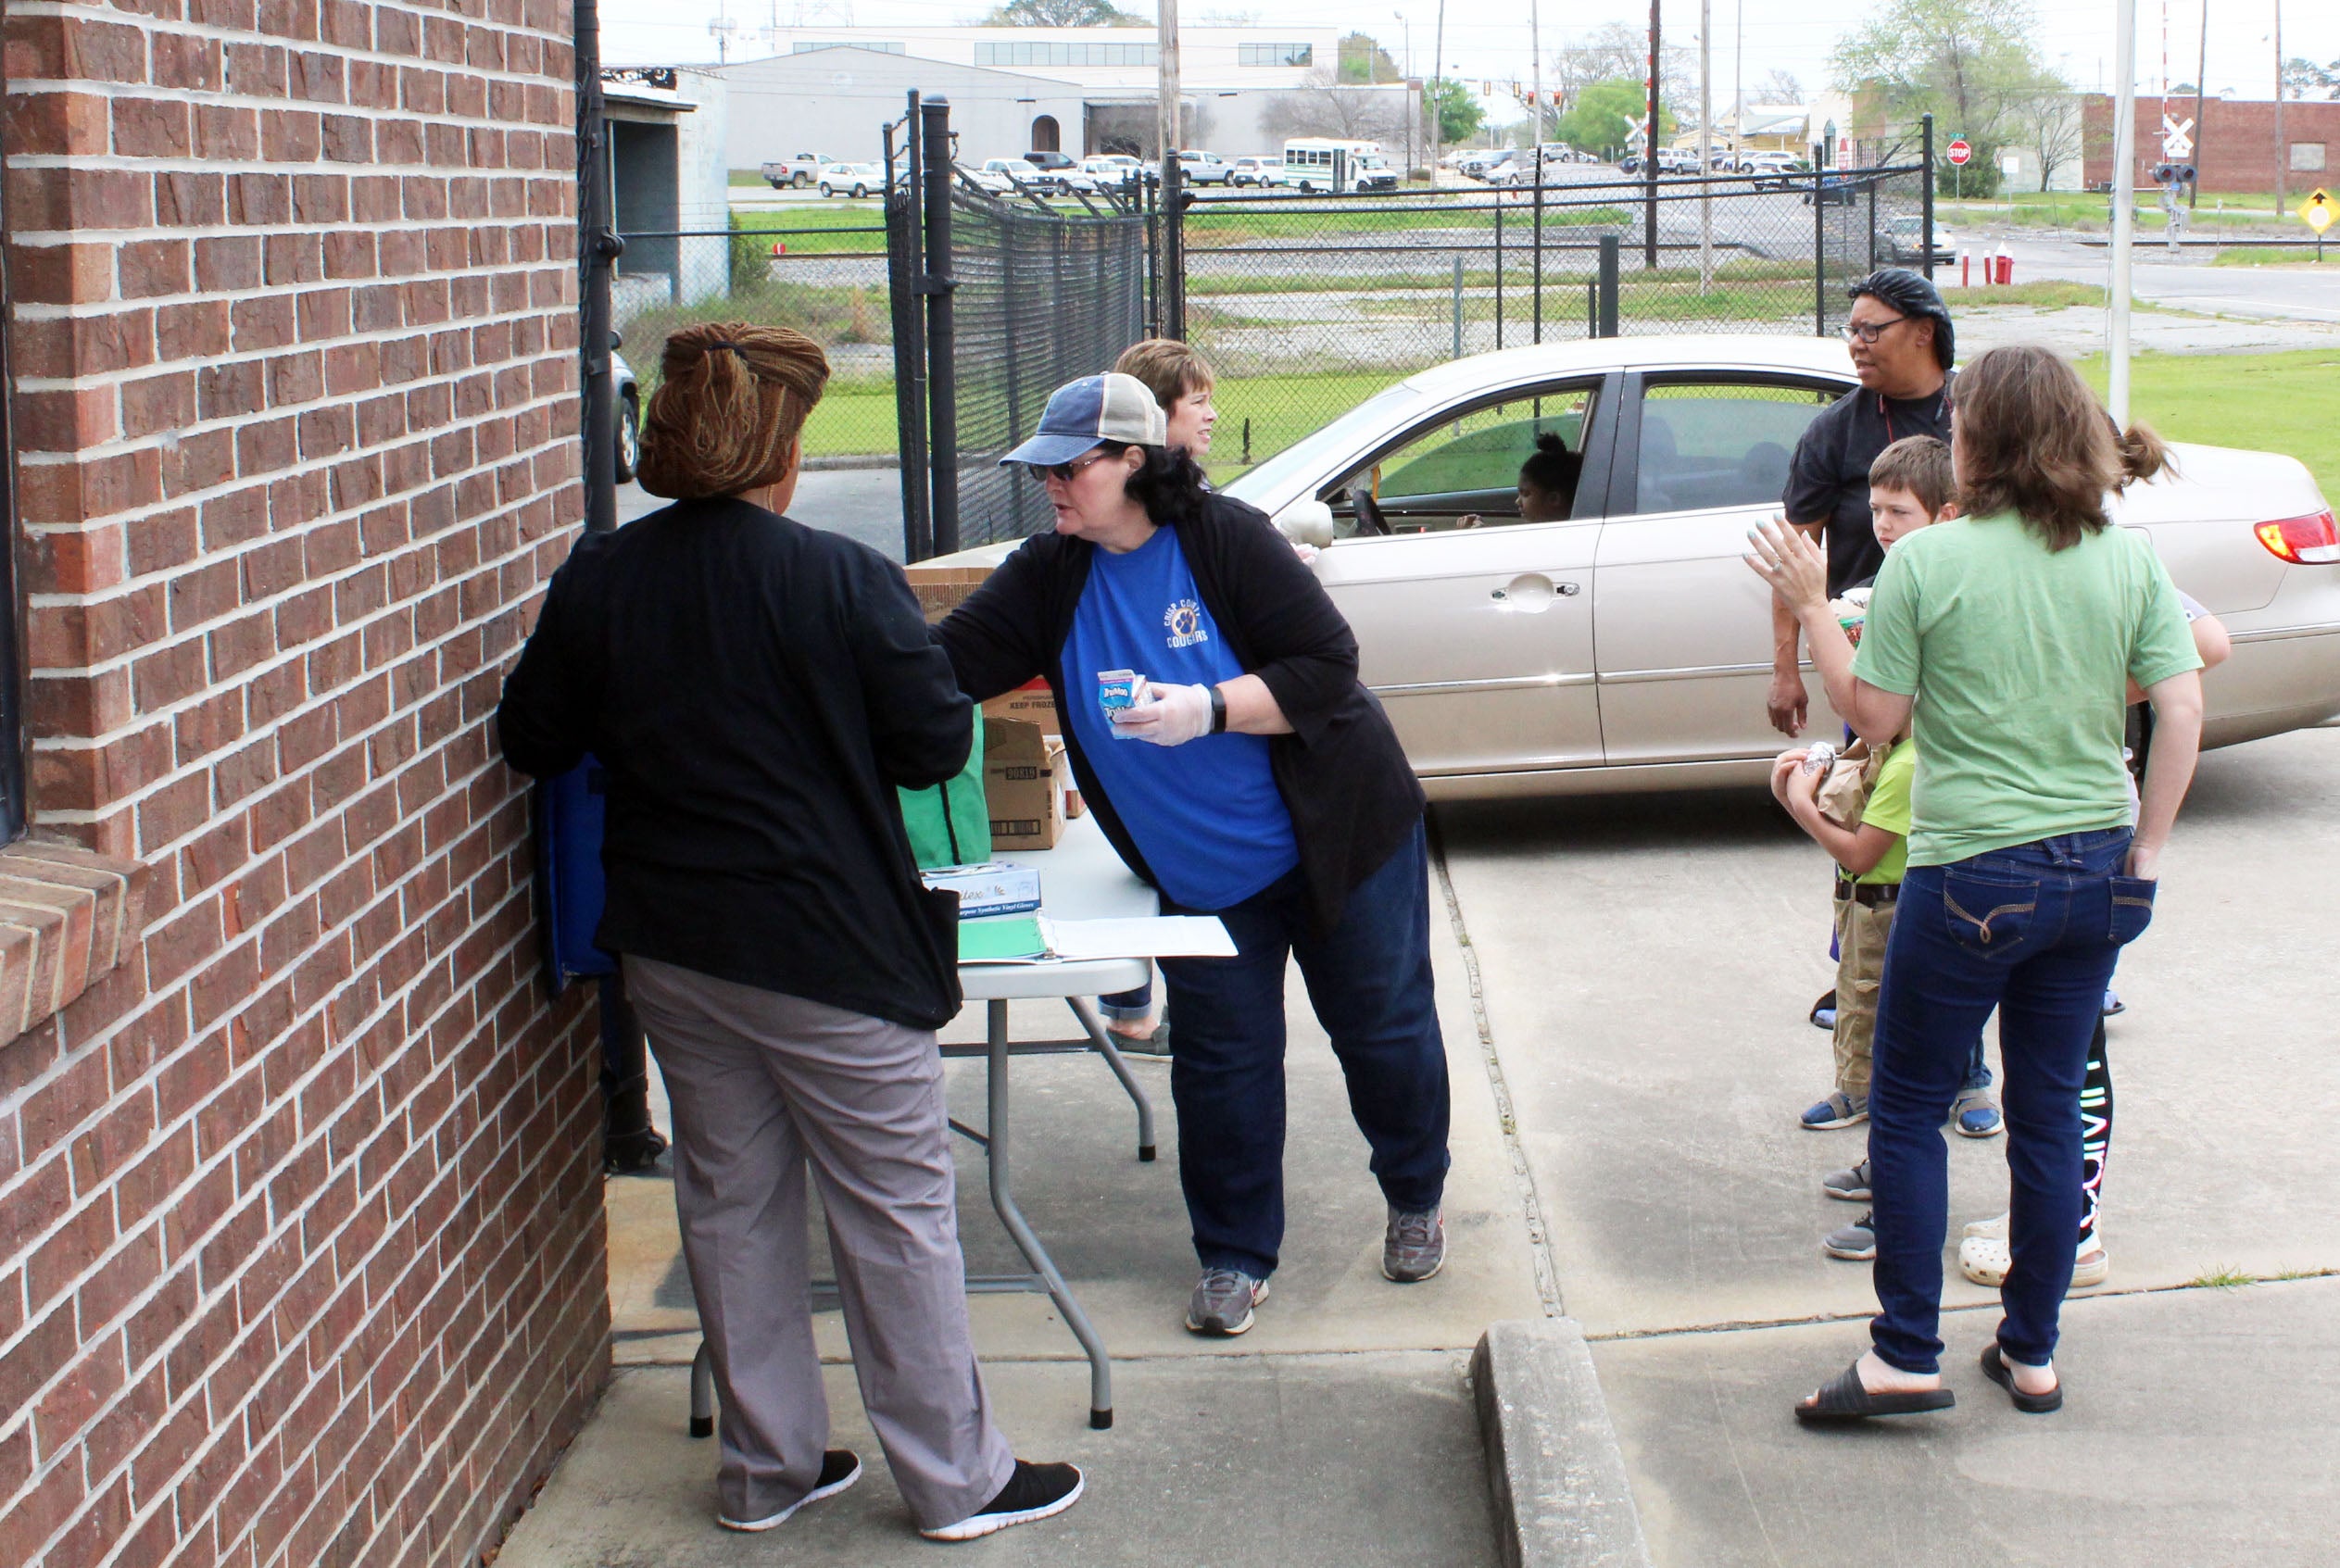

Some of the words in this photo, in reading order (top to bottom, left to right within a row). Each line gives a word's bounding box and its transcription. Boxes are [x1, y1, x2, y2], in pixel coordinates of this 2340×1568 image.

[1949, 148, 1969, 157] STOP
[1167, 630, 1208, 648] COUGARS
[1010, 701, 1029, 709] KEEP
[1032, 700, 1056, 709] FROZE
